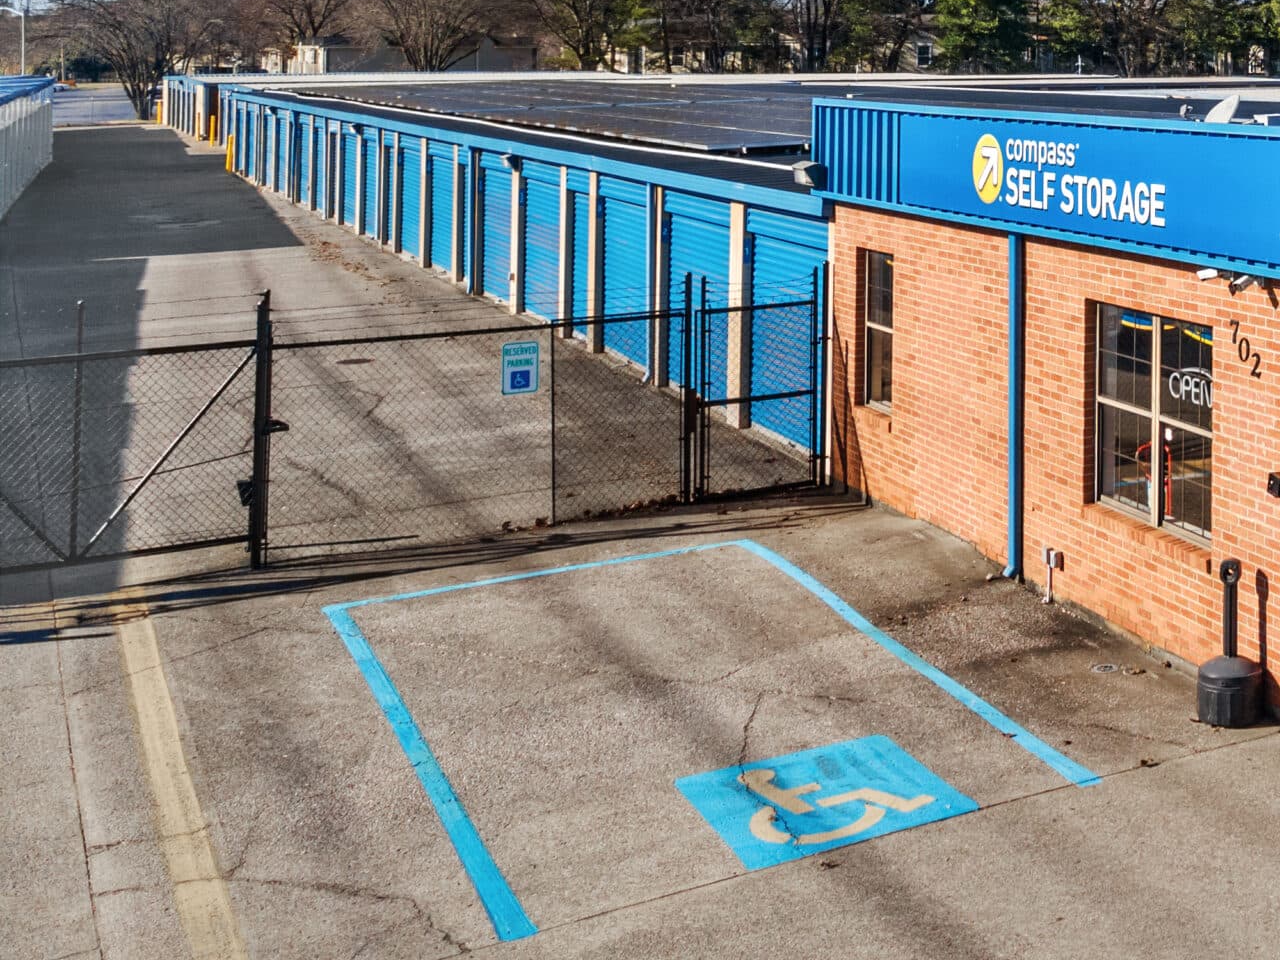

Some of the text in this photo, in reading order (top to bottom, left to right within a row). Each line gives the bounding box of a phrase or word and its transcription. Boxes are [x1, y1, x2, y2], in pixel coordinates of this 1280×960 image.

[1006, 137, 1074, 171] compass
[1006, 168, 1166, 227] SELF STORAGE
[503, 346, 537, 356] RESERVED
[1229, 319, 1262, 379] 702
[1169, 372, 1213, 409] OPEN
